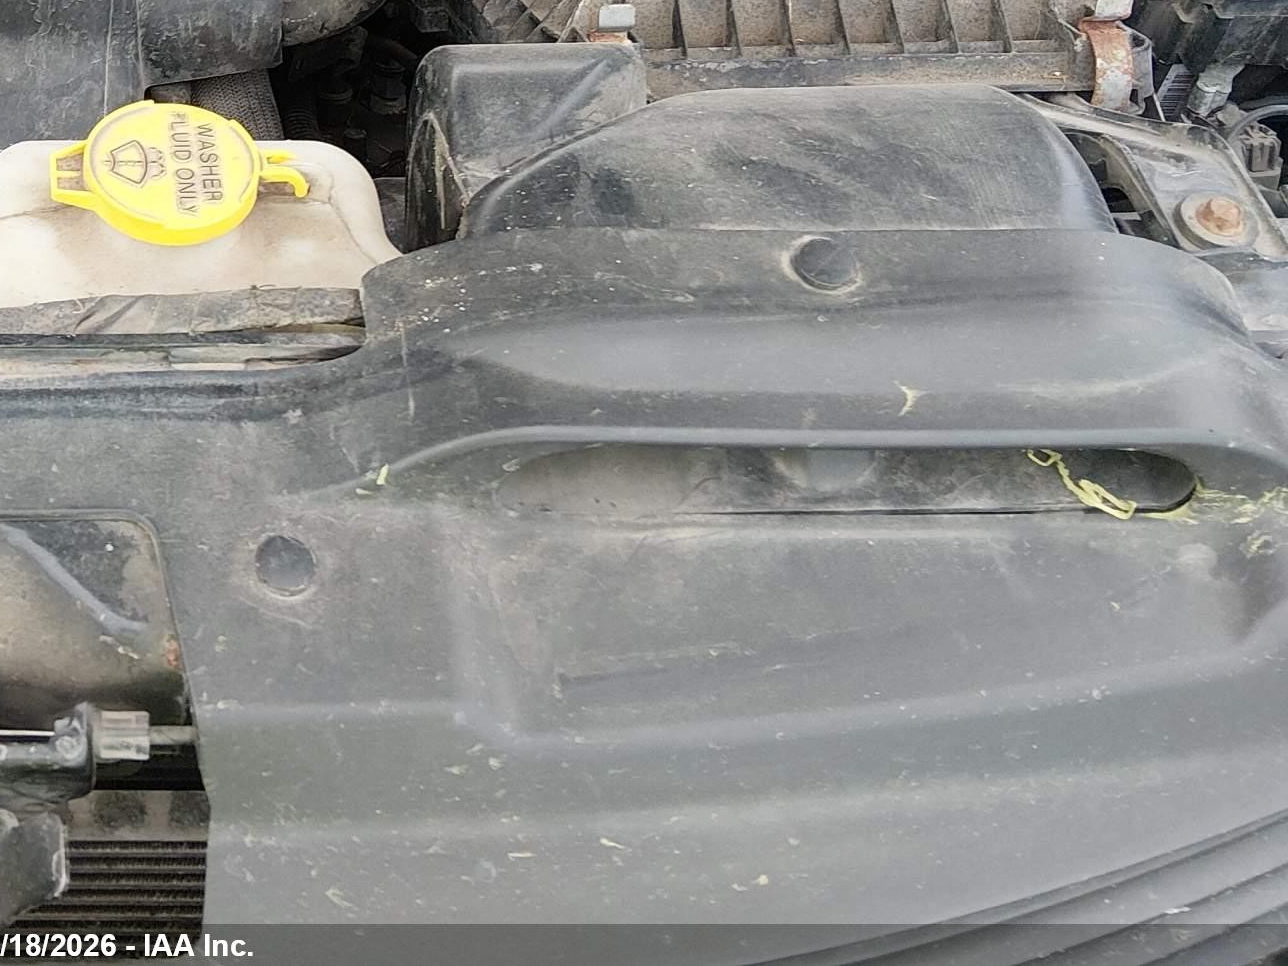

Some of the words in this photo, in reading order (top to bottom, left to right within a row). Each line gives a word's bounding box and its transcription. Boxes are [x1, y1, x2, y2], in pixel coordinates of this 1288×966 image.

[169, 110, 193, 162] FLUID
[197, 122, 224, 203] WASHER
[175, 168, 200, 217] ONLY
